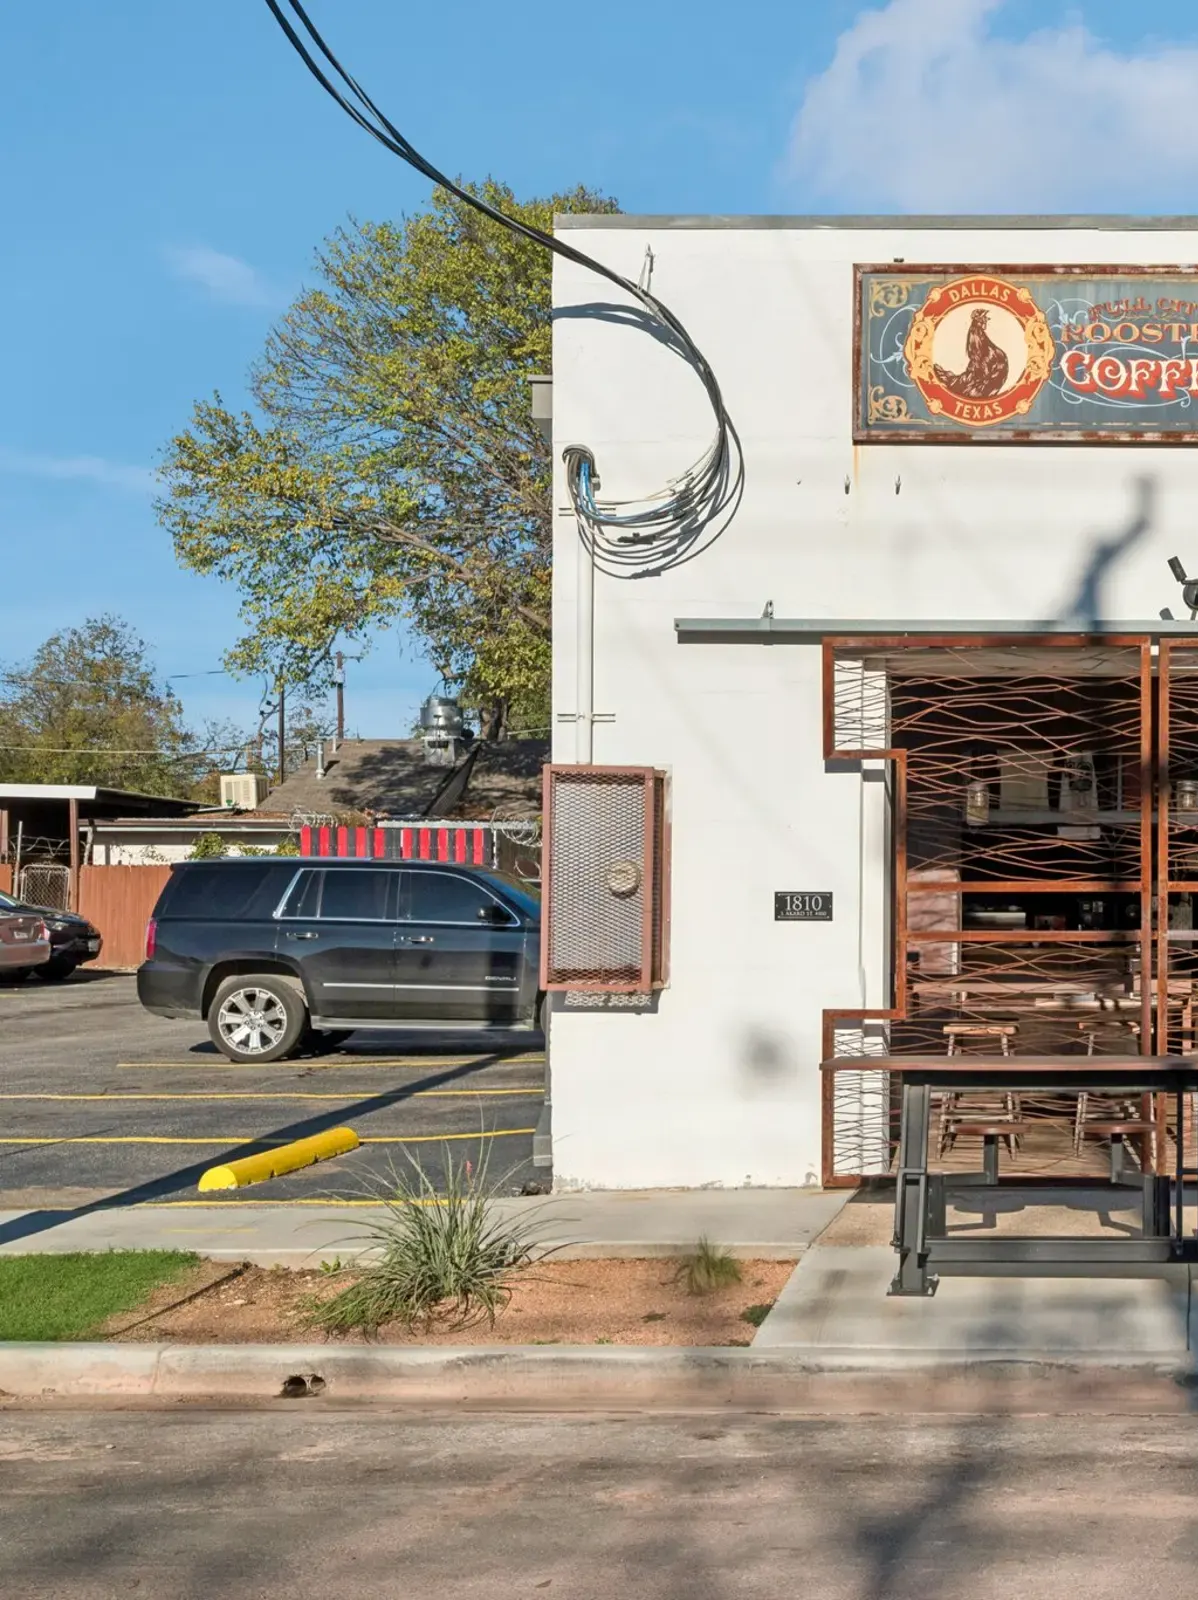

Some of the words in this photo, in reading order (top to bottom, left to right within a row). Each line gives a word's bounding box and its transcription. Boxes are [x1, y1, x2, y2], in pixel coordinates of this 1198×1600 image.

[948, 282, 1011, 302] DALLAS
[1088, 296, 1152, 322] FULL
[954, 402, 1003, 419] TEXAS
[784, 894, 823, 911] 1810
